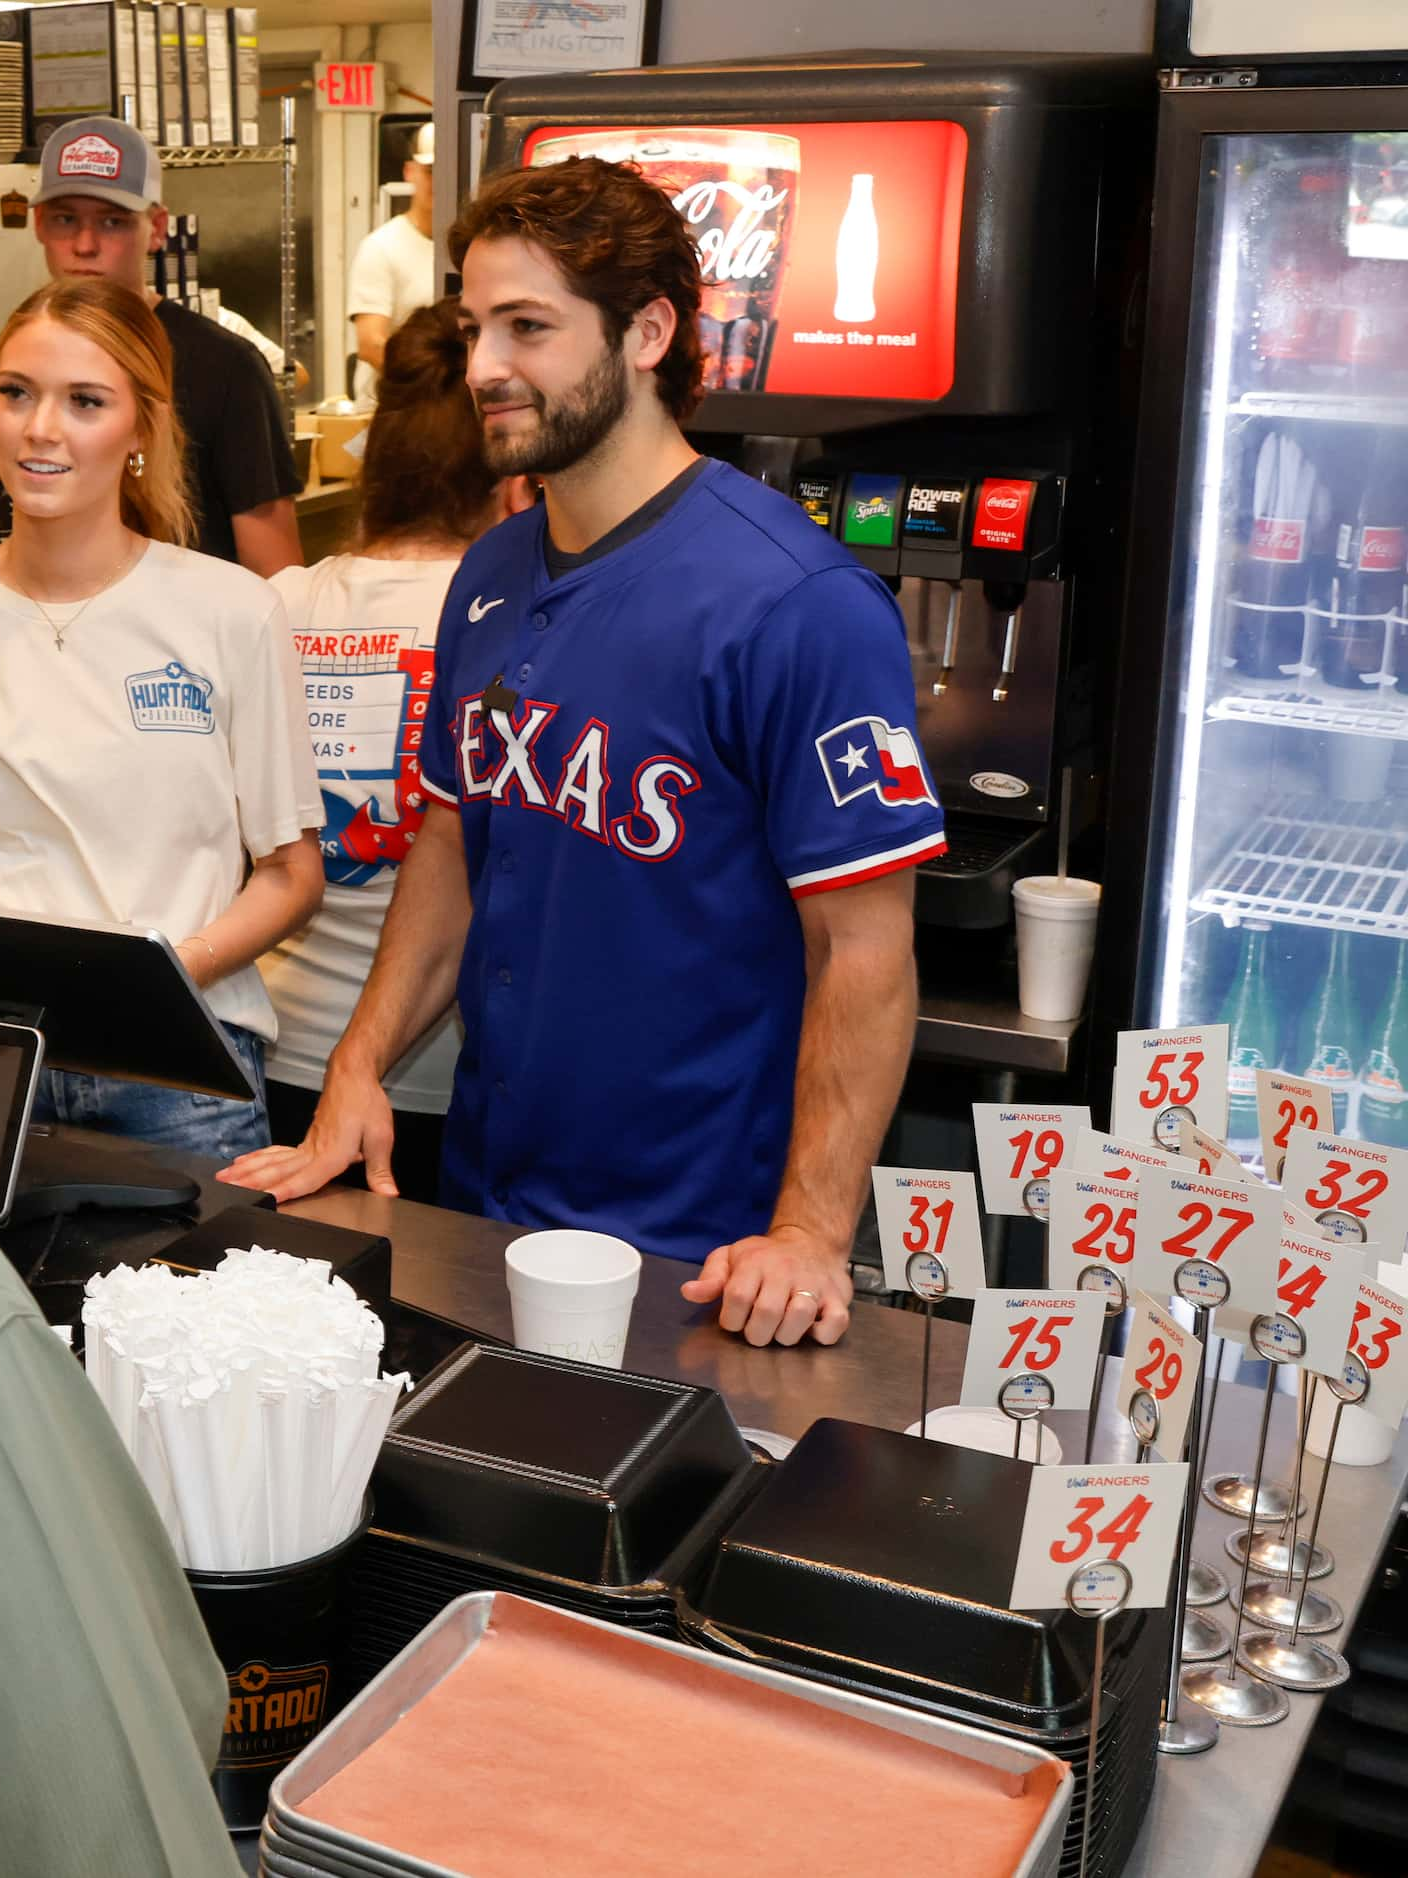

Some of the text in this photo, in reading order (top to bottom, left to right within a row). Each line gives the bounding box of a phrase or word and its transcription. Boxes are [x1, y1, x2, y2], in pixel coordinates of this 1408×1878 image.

[327, 64, 376, 107] EXIT
[793, 330, 917, 347] makes the meal
[857, 503, 889, 519] Sprite
[910, 487, 962, 504] POWER
[980, 529, 1017, 539] ORIGINAL
[986, 535, 1010, 544] TASTE
[340, 633, 399, 657] GAME
[305, 684, 354, 700] EEDS
[308, 713, 347, 728] ORE
[311, 742, 345, 757] XAS
[451, 690, 702, 863] EXAS
[1139, 1051, 1205, 1109] 53
[1008, 1129, 1064, 1179] 19
[1305, 1159, 1389, 1219] 32
[902, 1195, 955, 1254] 31
[1072, 1203, 1137, 1265] 25
[1161, 1202, 1255, 1263] 27
[1359, 1283, 1405, 1317] RANGERS
[998, 1315, 1074, 1371] 15
[1135, 1337, 1183, 1401] 29
[1049, 1493, 1154, 1564] 34
[223, 1683, 322, 1735] RTADO
